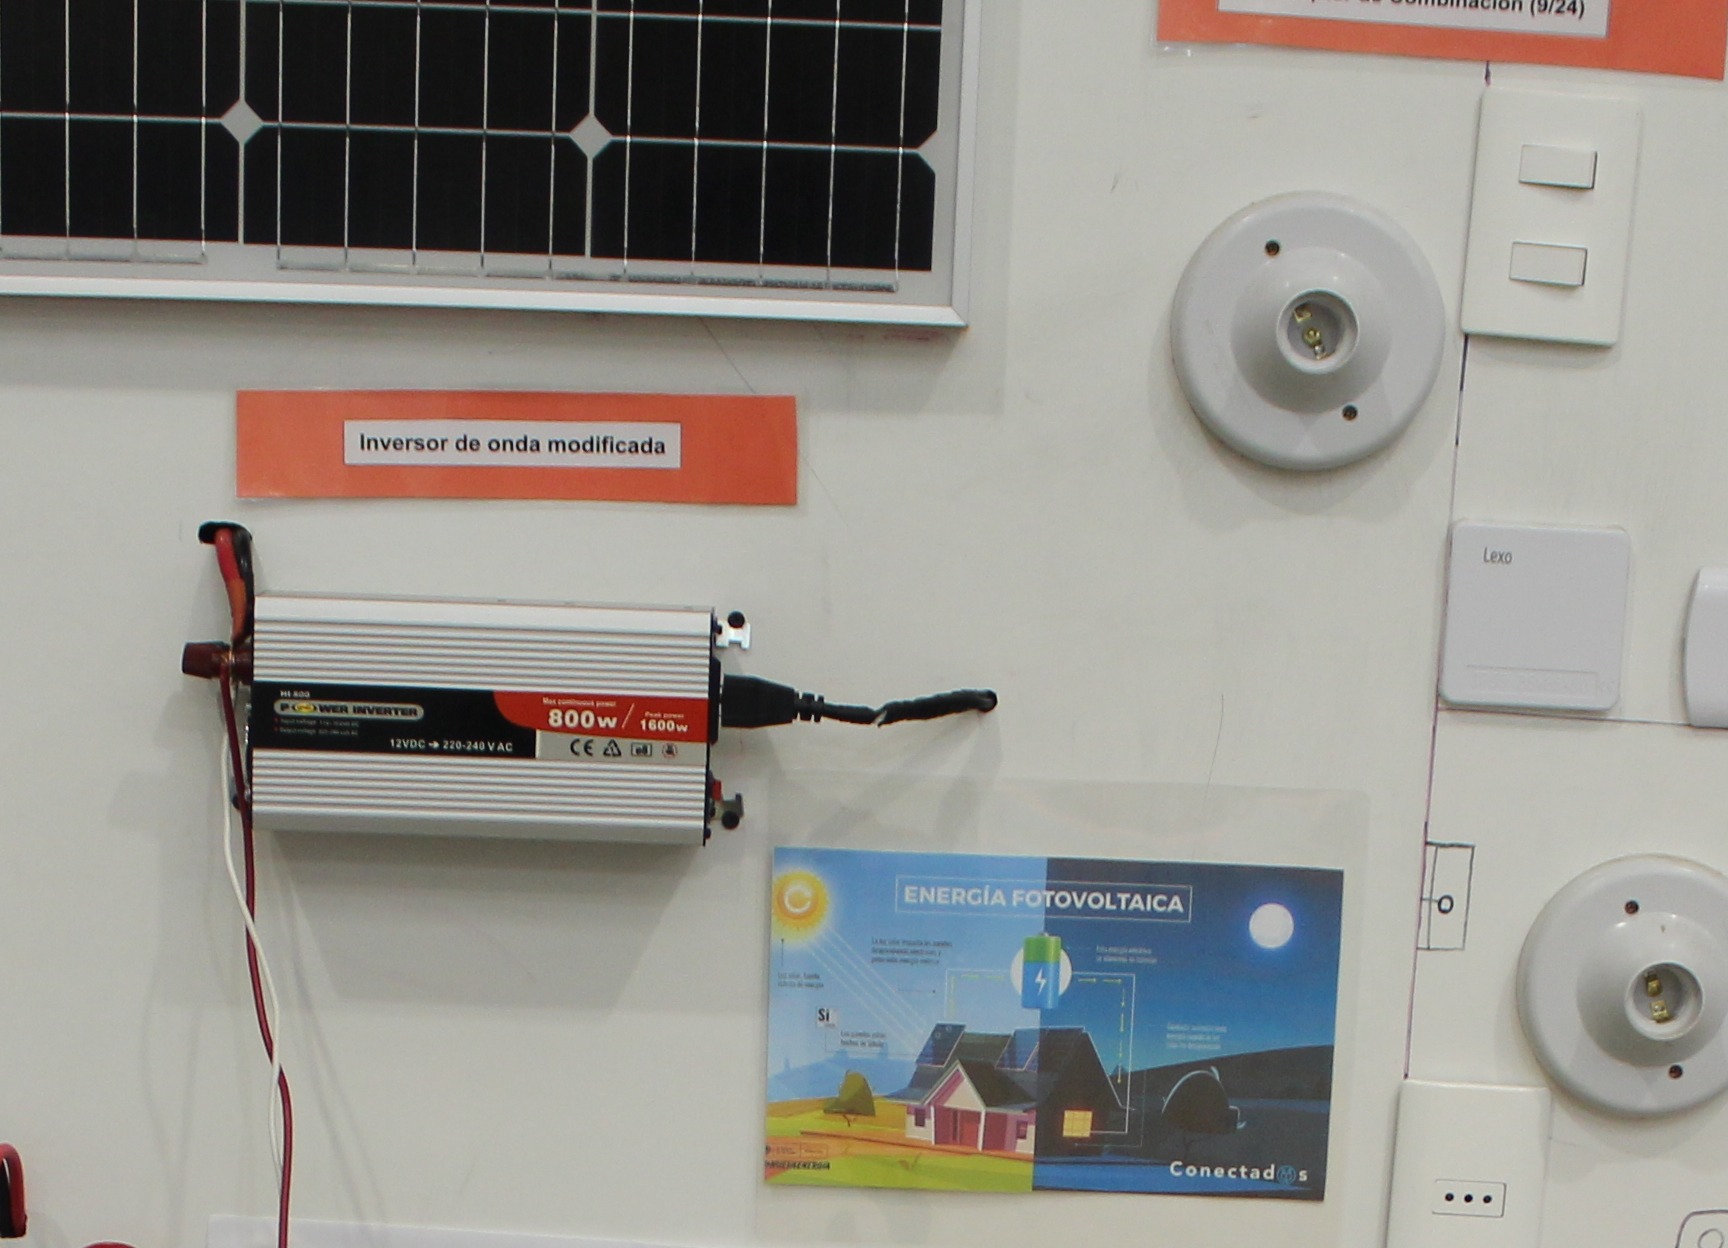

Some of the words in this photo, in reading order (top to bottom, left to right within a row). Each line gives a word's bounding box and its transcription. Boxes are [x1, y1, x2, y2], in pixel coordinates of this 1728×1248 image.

[1390, 0, 1523, 12] inación
[359, 433, 448, 452] Inversor
[455, 434, 481, 452] de
[487, 434, 541, 453] onda
[547, 434, 666, 455] modificada
[1483, 546, 1513, 564] Lexo
[352, 706, 418, 717] INVERTER
[548, 709, 618, 729] 800w
[640, 718, 689, 733] 1600w
[390, 738, 425, 749] 12VDC
[443, 740, 485, 751] 220-240
[487, 741, 496, 750] V
[497, 742, 513, 752] AC
[904, 884, 1008, 907] ENERGÍA
[1012, 890, 1184, 913] FOTOVOLTAICA
[818, 1008, 830, 1021] Si
